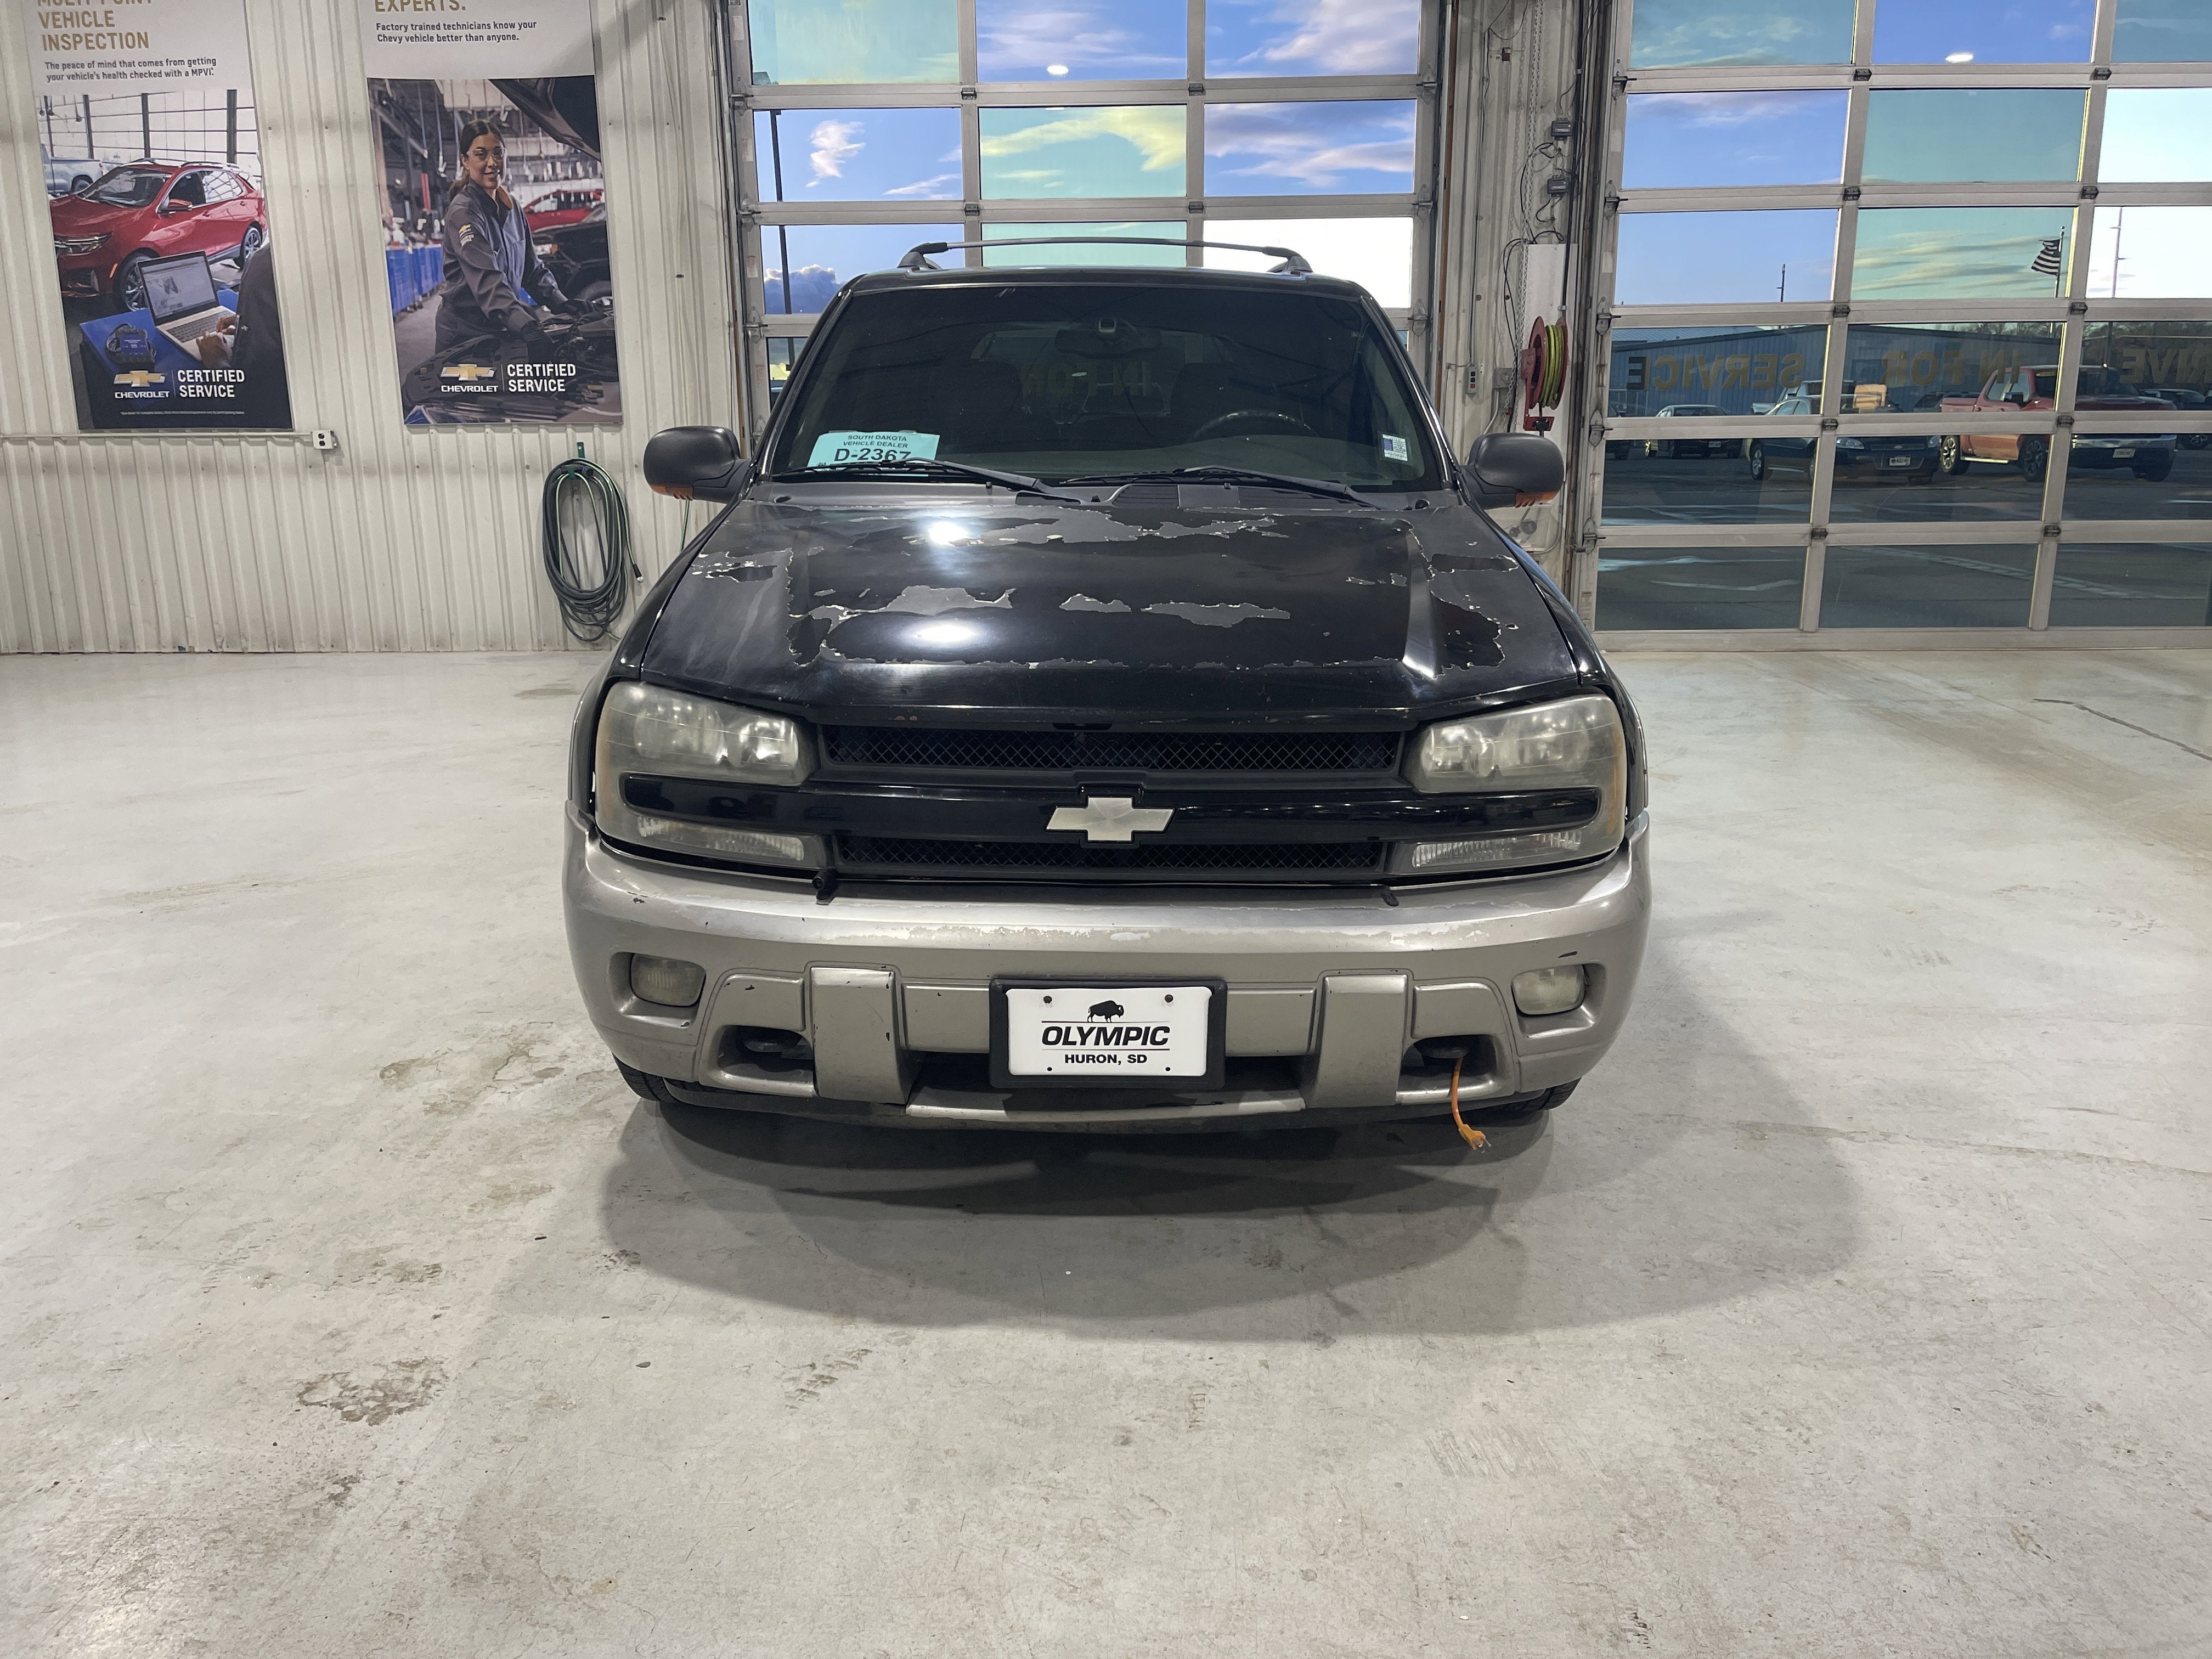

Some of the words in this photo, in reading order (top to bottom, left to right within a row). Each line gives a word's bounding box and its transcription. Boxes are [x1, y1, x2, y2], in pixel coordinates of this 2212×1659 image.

[38, 10, 115, 29] VEHICLE
[376, 22, 408, 32] Factory
[411, 22, 441, 31] trained
[443, 21, 491, 30] technicians
[493, 21, 515, 29] know
[517, 21, 537, 30] your
[42, 32, 149, 51] INSPECTION
[377, 34, 402, 43] Chevy
[405, 33, 434, 42] vehicle
[437, 33, 462, 42] better
[487, 34, 519, 42] anyone.
[62, 63, 84, 71] peace
[188, 57, 216, 67] getting
[47, 74, 64, 82] your
[66, 72, 100, 81] vehicle's
[129, 70, 162, 78] checked
[177, 370, 245, 382] CERTIFIED
[507, 363, 576, 376] CERTIFIED
[179, 385, 235, 398] SERVICE
[508, 379, 566, 392] SERVICE
[115, 391, 170, 399] CHEVROLET
[834, 448, 911, 462] D-2367
[1041, 1026, 1170, 1046] OLYMPIC
[1065, 1054, 1121, 1065] HURON,
[1127, 1054, 1147, 1064] SD
